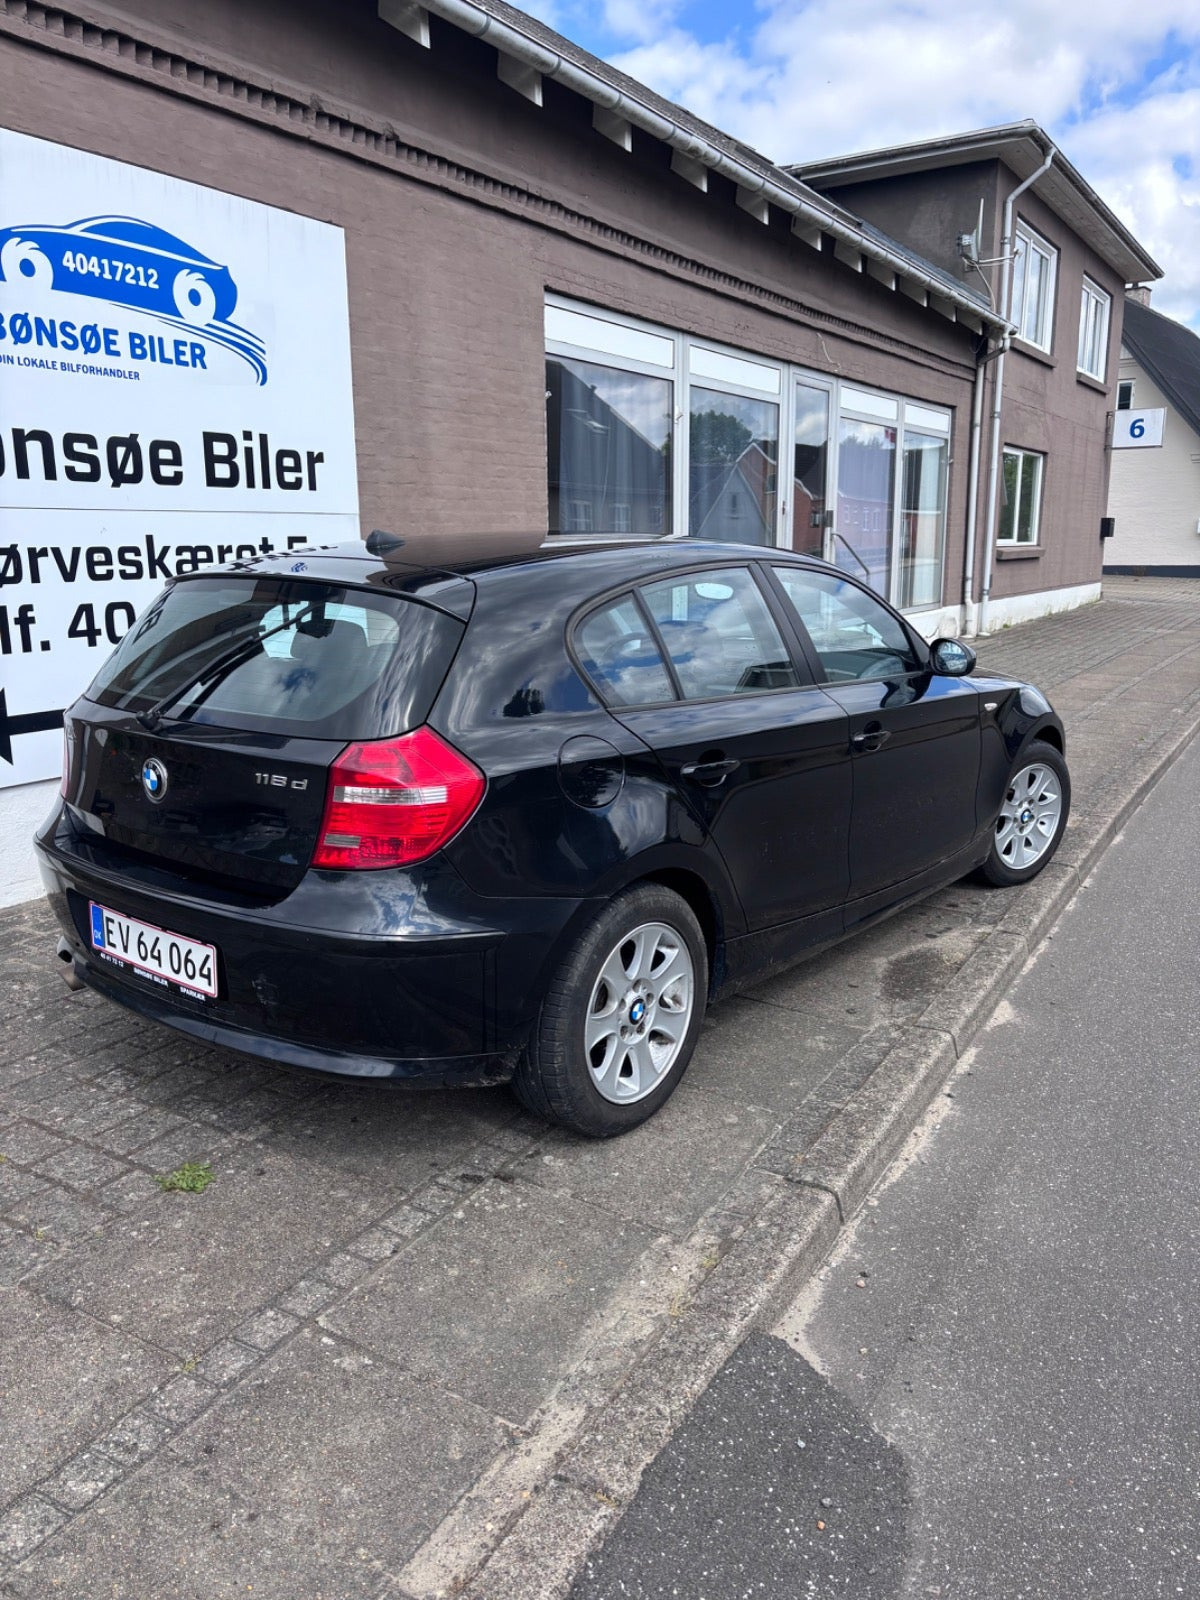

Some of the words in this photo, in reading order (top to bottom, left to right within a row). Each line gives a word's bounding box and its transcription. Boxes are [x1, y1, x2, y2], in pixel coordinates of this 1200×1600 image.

[62, 251, 159, 289] 40417212
[0, 354, 14, 365] IN
[17, 356, 58, 370] LOKALE
[60, 362, 140, 380] BILFORHANDLER
[128, 332, 207, 370] BILER
[1129, 418, 1145, 438] 6
[0, 428, 183, 488] nsøe
[202, 430, 324, 491] Biler
[67, 601, 137, 647] 40
[105, 916, 129, 954] EV
[137, 931, 161, 968] 64
[169, 942, 212, 987] 064
